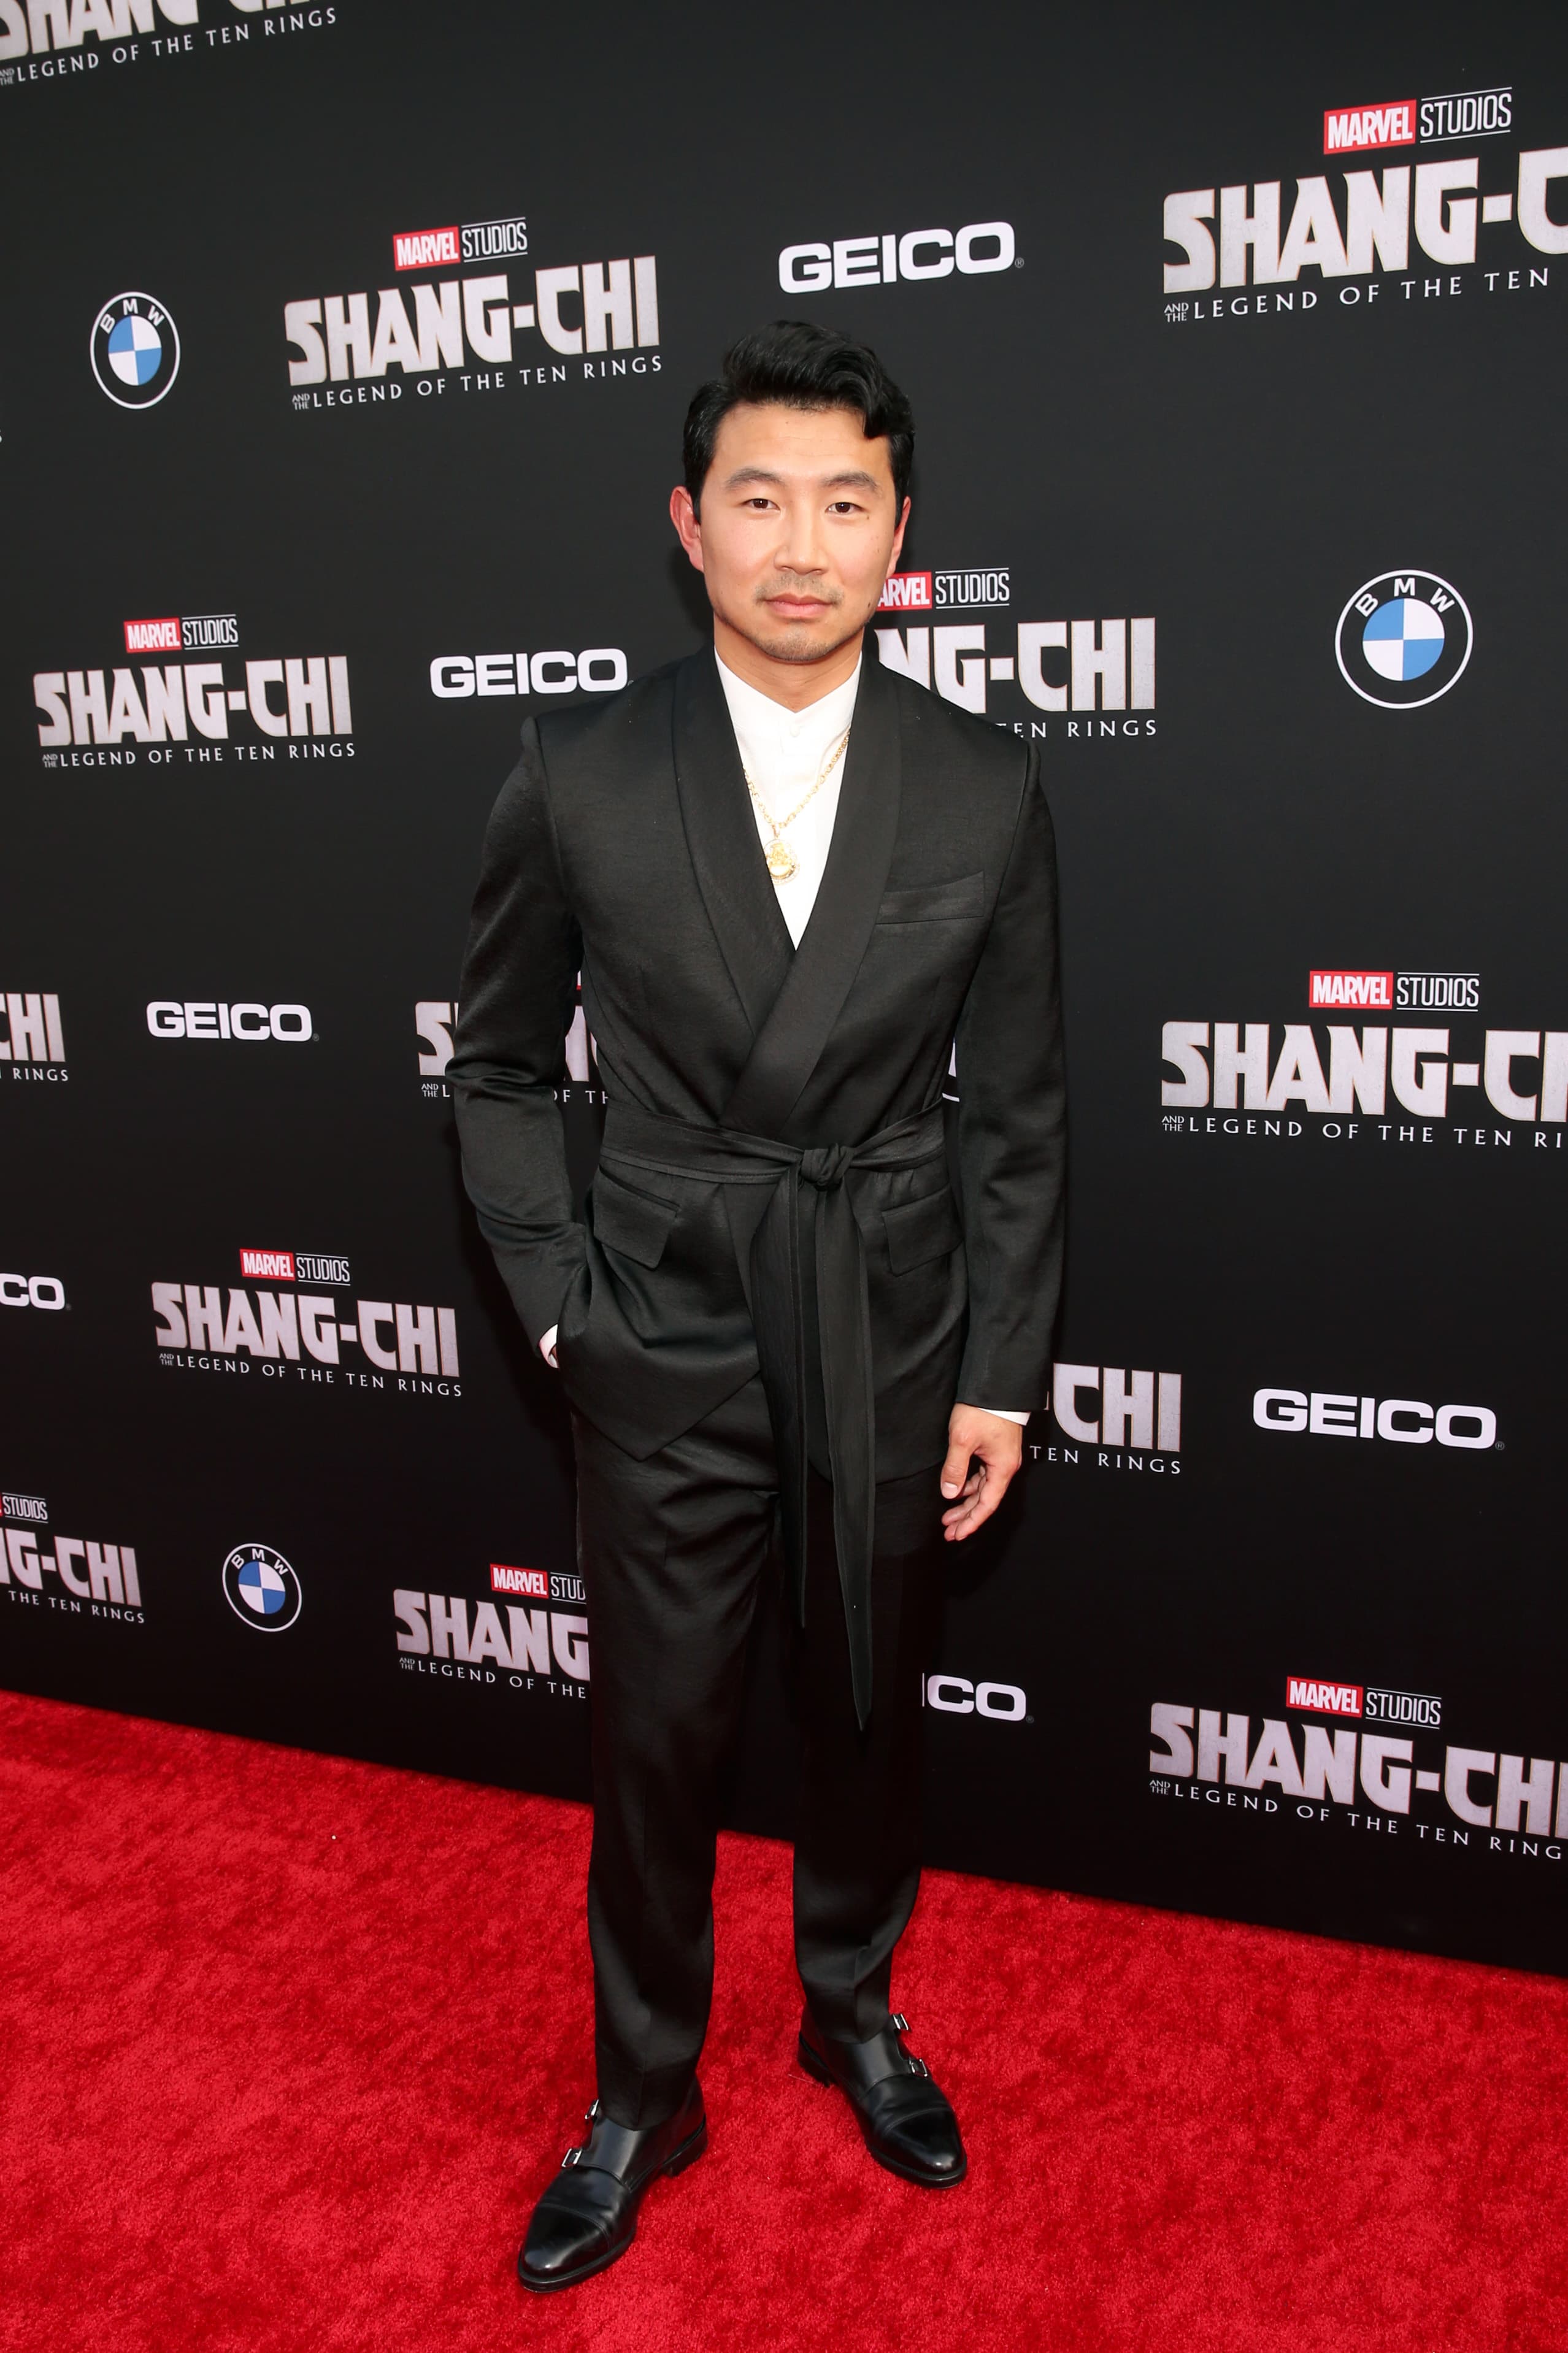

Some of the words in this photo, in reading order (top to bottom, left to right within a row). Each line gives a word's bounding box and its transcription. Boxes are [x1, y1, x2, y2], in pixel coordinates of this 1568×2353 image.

[17, 53, 99, 82] LEGEND
[112, 44, 139, 63] OF
[151, 34, 193, 56] THE
[206, 23, 249, 46] TEN
[264, 7, 336, 36] RINGS
[1327, 106, 1413, 150] MARVEL
[1420, 93, 1512, 137] STUDIOS
[1163, 146, 1568, 294] SHANG-C
[396, 236, 459, 267] MARVEL
[461, 223, 528, 256] STUDIOS
[1164, 302, 1189, 314] AND
[1194, 291, 1318, 320] LEGEND
[1339, 284, 1380, 305] OF
[1400, 276, 1462, 299] THE
[1484, 267, 1548, 291] TEN
[99, 297, 165, 334] BMW
[284, 255, 660, 386] SHANG-CHI
[1165, 311, 1188, 323] THE
[291, 393, 310, 402] AND
[313, 383, 402, 408] LEGEND
[417, 378, 445, 396] OF
[459, 372, 505, 391] THE
[519, 365, 566, 385] TEN
[583, 355, 662, 379] RINGS
[293, 401, 310, 410] THE
[877, 577, 931, 607] ARVEL
[935, 572, 1010, 605] STUDIOS
[1355, 577, 1455, 618] BMW
[126, 621, 181, 650] MARVEL
[182, 618, 239, 647] STUDIOS
[429, 648, 628, 699] GEICO
[874, 617, 1156, 714] NG-CHI
[33, 656, 353, 747] SHANG-CHI
[1067, 719, 1156, 737] RINGS
[60, 751, 136, 767] LEGEND
[148, 749, 172, 764] OF
[184, 747, 223, 762] THE
[234, 745, 275, 761] TEN
[288, 742, 355, 759] RINGS
[1312, 975, 1391, 1005] MARVEL
[1396, 977, 1480, 1008] STUDIOS
[146, 1001, 313, 1042] GEICO
[12, 1067, 69, 1082] RINGS
[1161, 1115, 1185, 1124] AND
[1163, 1123, 1183, 1132] THE
[1189, 1116, 1302, 1137] LEGEND
[1322, 1123, 1359, 1139] OF
[1377, 1125, 1434, 1143] THE
[1453, 1128, 1512, 1146] TEN
[242, 1252, 294, 1278] MARVEL
[297, 1256, 350, 1283] STUDIOS
[152, 1282, 459, 1377] SHANG-CHI
[177, 1354, 250, 1373] LEGEND
[262, 1364, 285, 1378] OF
[297, 1367, 334, 1383] THE
[345, 1373, 384, 1389] TEN
[398, 1378, 462, 1397] RINGS
[1029, 1445, 1078, 1464] TEN
[1098, 1453, 1180, 1475] RINGS
[2, 1495, 48, 1521] STUDIOS
[231, 1548, 289, 1575] BMW
[493, 1567, 547, 1595] MARVEL
[550, 1576, 586, 1600] STUD
[8, 1590, 39, 1605] THE
[48, 1597, 80, 1613] TEN
[91, 1605, 144, 1624] RINGS
[393, 1589, 590, 1681] SHANG
[418, 1660, 496, 1683] LEGEND
[509, 1676, 534, 1689] OF
[547, 1681, 586, 1699] THE
[1289, 1680, 1360, 1714] MARVEL
[1366, 1691, 1442, 1725] STUDIOS
[1149, 1779, 1170, 1788] AND
[1150, 1786, 1169, 1795] THE
[1175, 1784, 1278, 1812] LEGEND
[1296, 1805, 1329, 1821] OF
[1347, 1813, 1397, 1834] THE
[1416, 1824, 1469, 1846] TEN
[1489, 1836, 1561, 1860] RING
